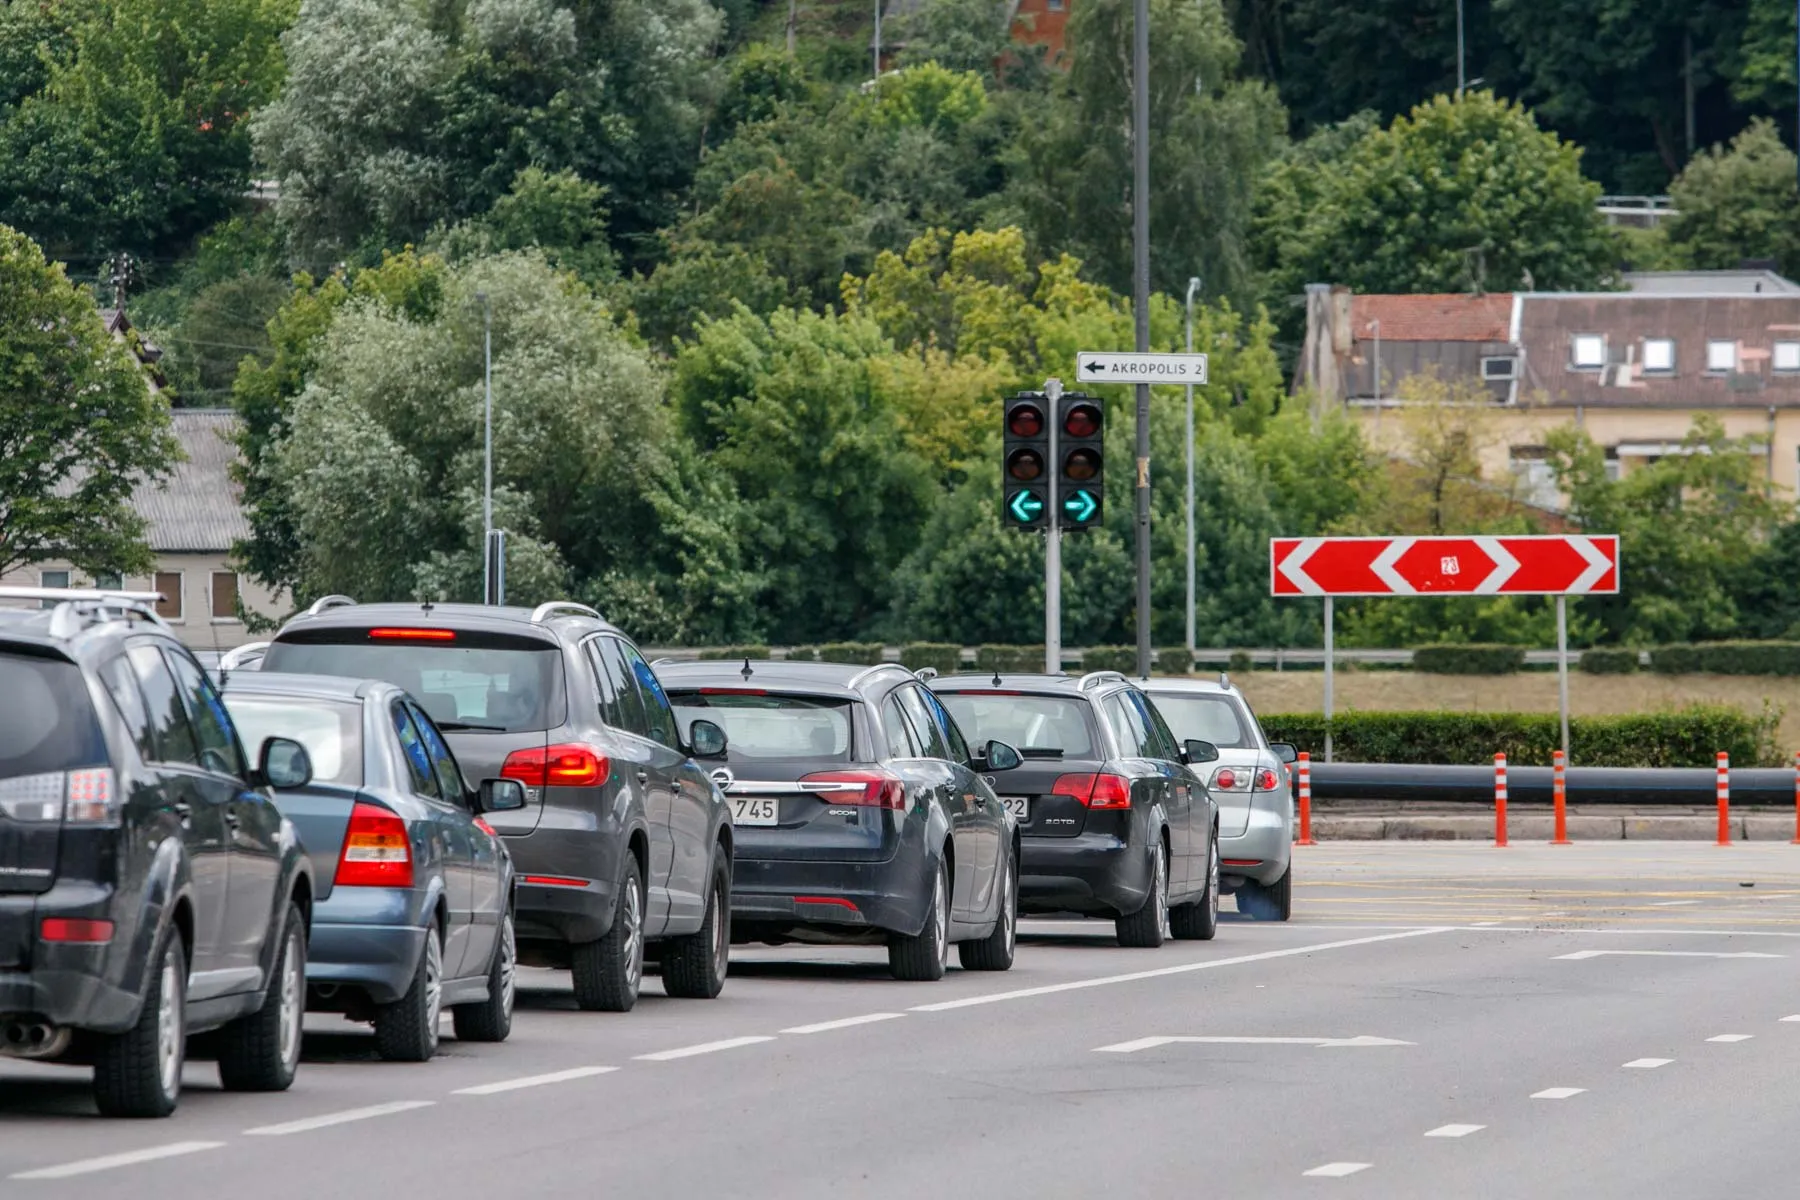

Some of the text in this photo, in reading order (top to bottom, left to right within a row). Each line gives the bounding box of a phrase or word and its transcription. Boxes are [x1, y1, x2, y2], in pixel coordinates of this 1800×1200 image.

[1111, 363, 1202, 375] AKROPOLIS 2
[735, 799, 773, 819] 745
